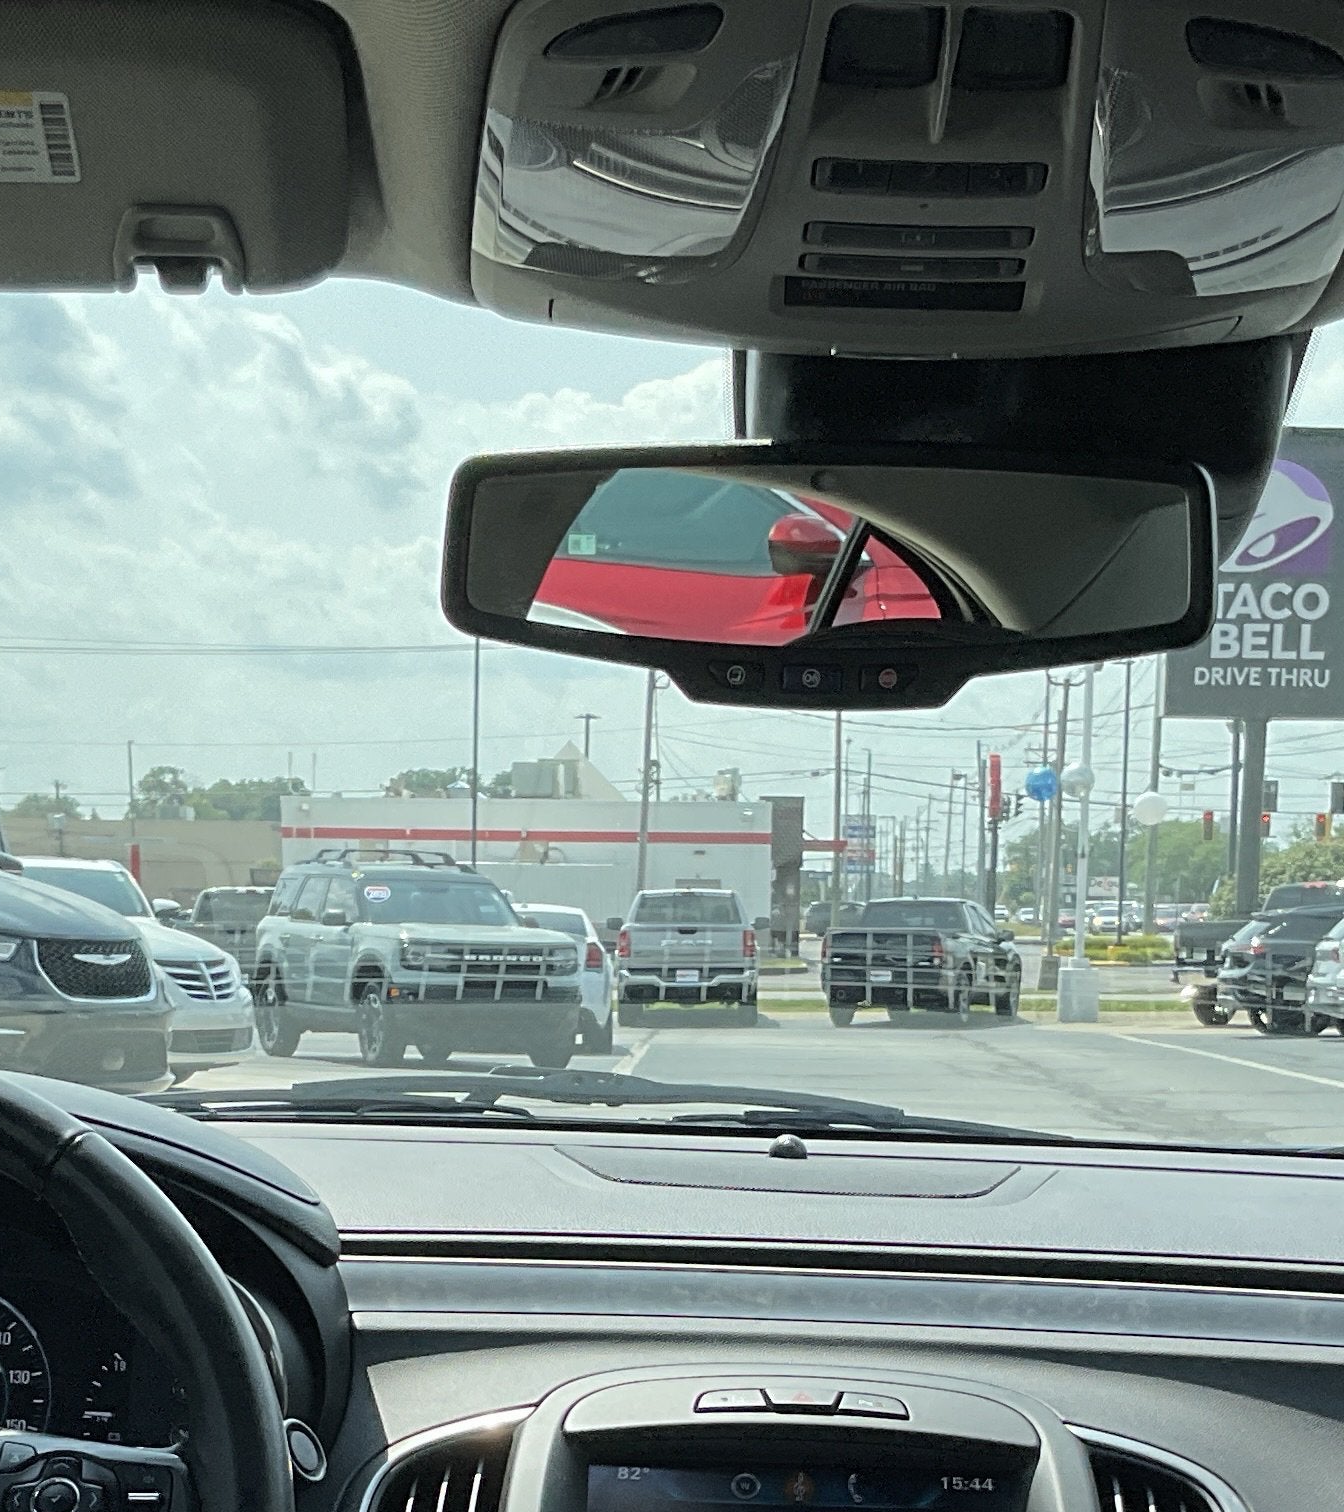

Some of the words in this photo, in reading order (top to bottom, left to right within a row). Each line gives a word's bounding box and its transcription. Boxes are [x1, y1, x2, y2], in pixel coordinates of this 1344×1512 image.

[1217, 582, 1331, 621] TACO
[1209, 623, 1325, 661] BELL
[1193, 666, 1262, 687] DRIVE
[1267, 667, 1331, 688] THRU
[8, 1369, 31, 1385] 130
[940, 1476, 994, 1491] 15:44
